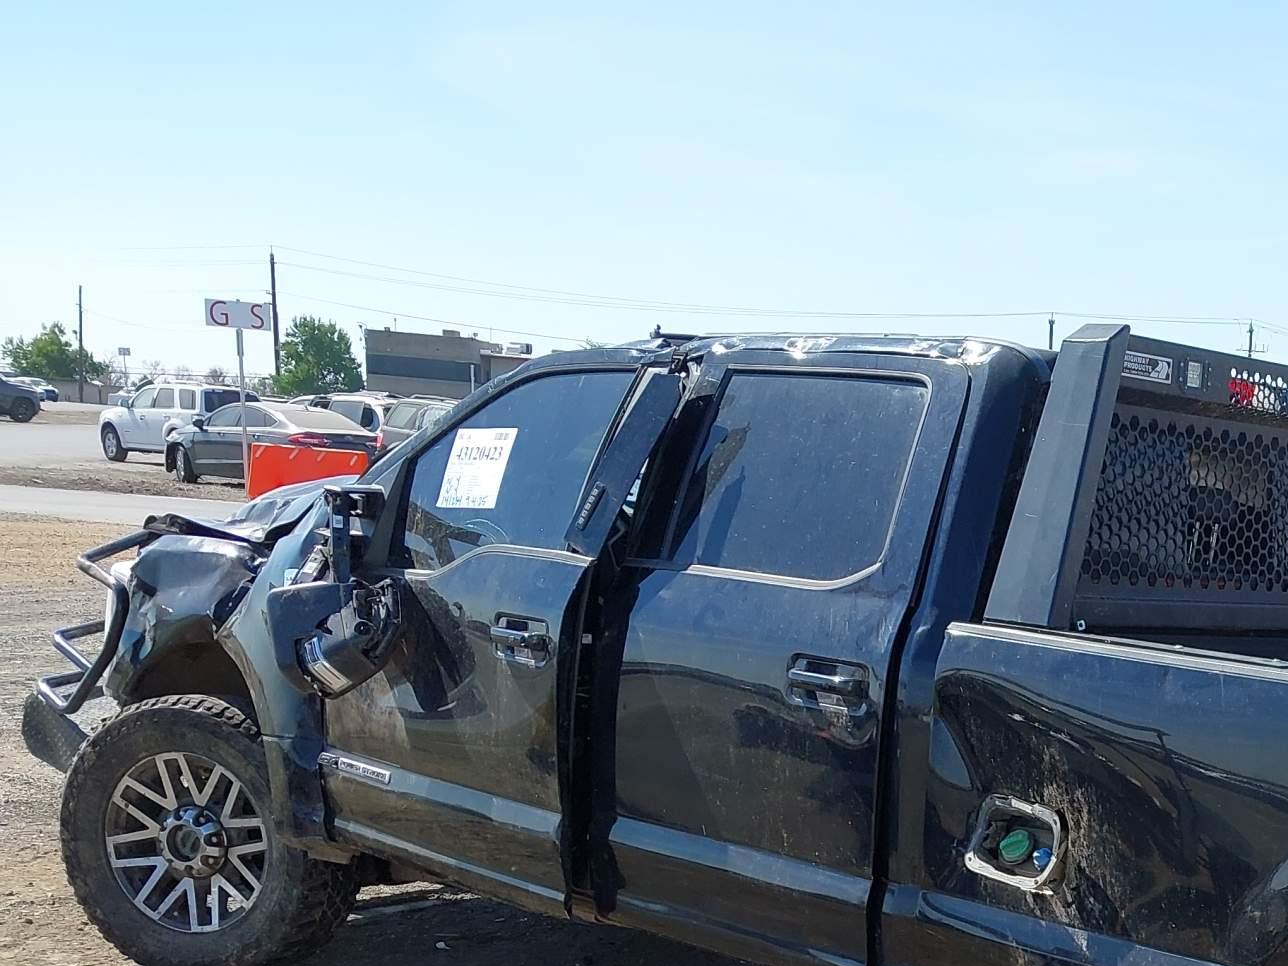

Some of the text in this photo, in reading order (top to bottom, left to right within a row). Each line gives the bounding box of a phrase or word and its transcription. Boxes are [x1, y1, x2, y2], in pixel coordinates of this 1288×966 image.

[210, 300, 264, 329] G S
[1123, 361, 1152, 372] PRODUCTS
[456, 446, 504, 461] 43120423
